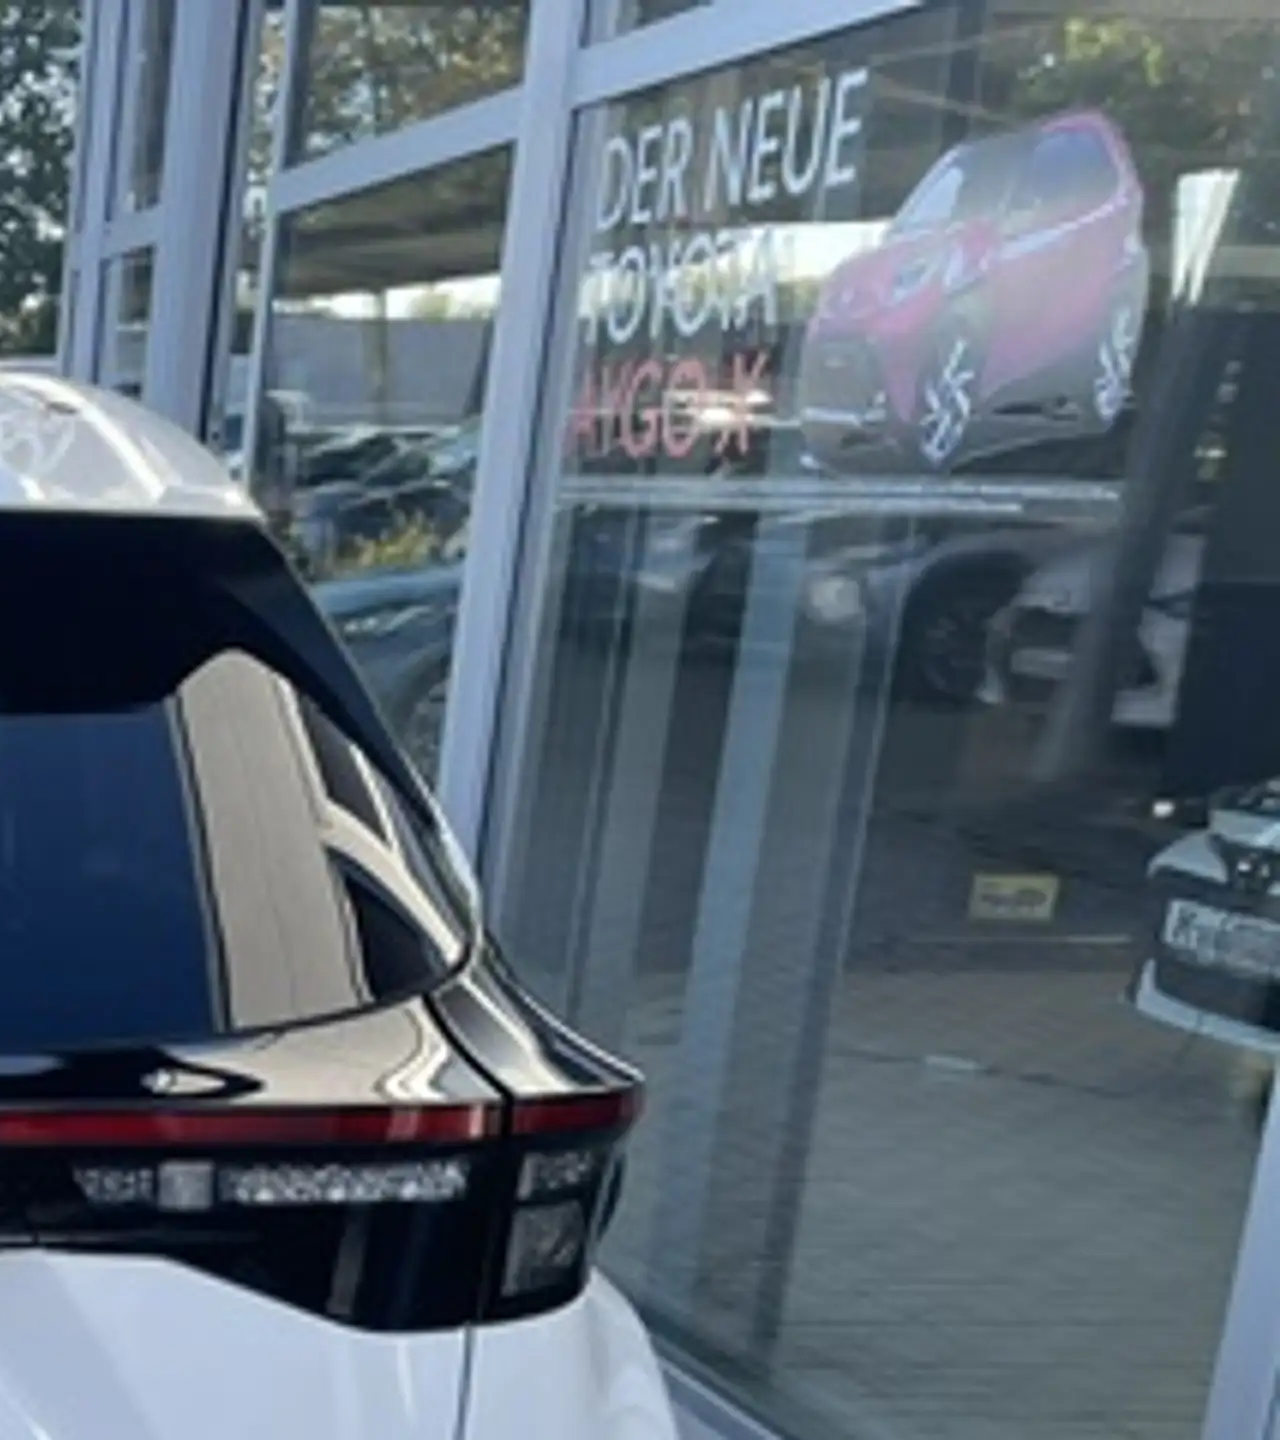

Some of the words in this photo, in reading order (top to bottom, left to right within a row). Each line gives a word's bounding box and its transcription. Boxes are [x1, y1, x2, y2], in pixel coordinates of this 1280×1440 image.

[596, 115, 694, 232] DER
[704, 67, 869, 213] NEUE
[578, 227, 780, 345] TOYOTA
